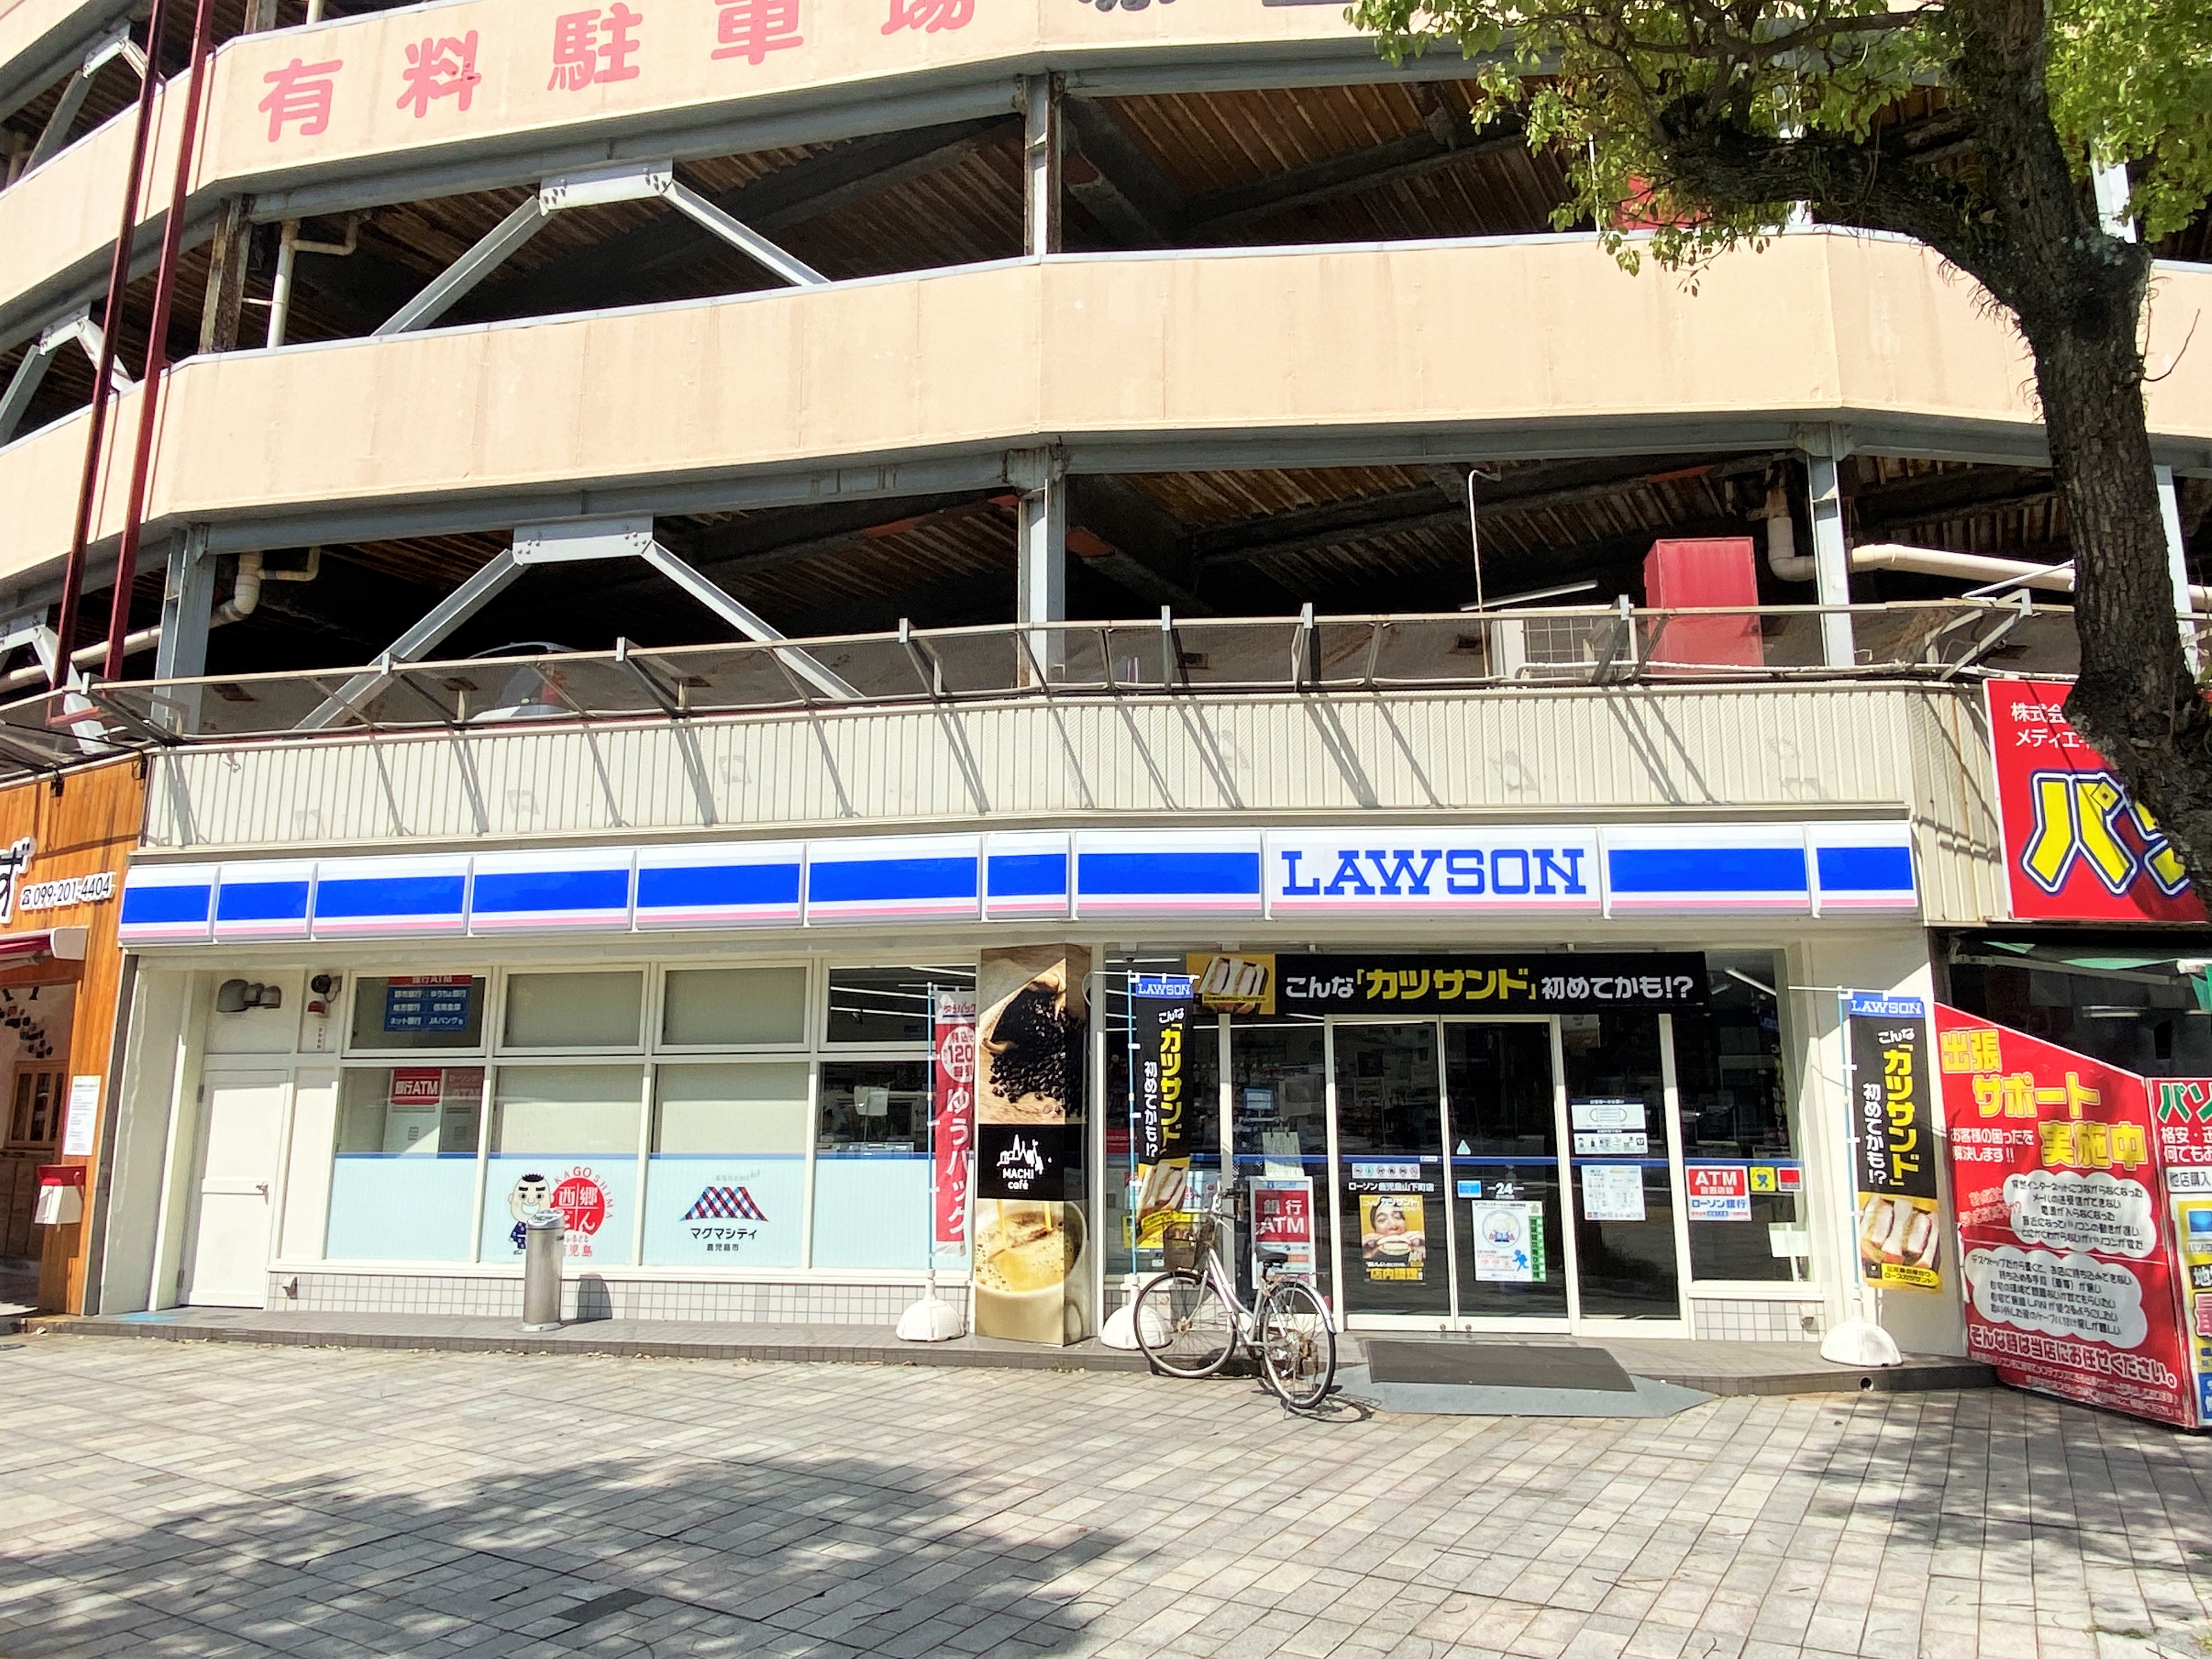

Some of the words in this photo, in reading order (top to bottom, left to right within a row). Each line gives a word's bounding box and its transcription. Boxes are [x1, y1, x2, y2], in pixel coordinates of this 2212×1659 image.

[1280, 848, 1587, 895] LAWSON
[33, 875, 111, 906] 099-201-4404
[1138, 983, 1191, 996] LAWSON
[1850, 1000, 1922, 1015] LAWSON
[947, 1044, 973, 1064] 120
[1940, 1029, 2002, 1074] 出張
[394, 1080, 438, 1095] 銀行ATM
[1972, 1071, 2101, 1119] サポート
[2038, 1119, 2149, 1171] 実施中
[1002, 1167, 1034, 1180] MACHI
[1695, 1171, 1737, 1186] ATM
[1007, 1179, 1029, 1190] café
[1496, 1182, 1514, 1194] 24
[554, 1166, 614, 1220] KAGOSHIMA
[1263, 1199, 1303, 1215] 銀行
[1691, 1199, 1746, 1209] ローソン銀行
[1261, 1216, 1305, 1234] ATM
[690, 1228, 758, 1240] マグマシティ
[707, 1243, 740, 1251] 鹿児島市
